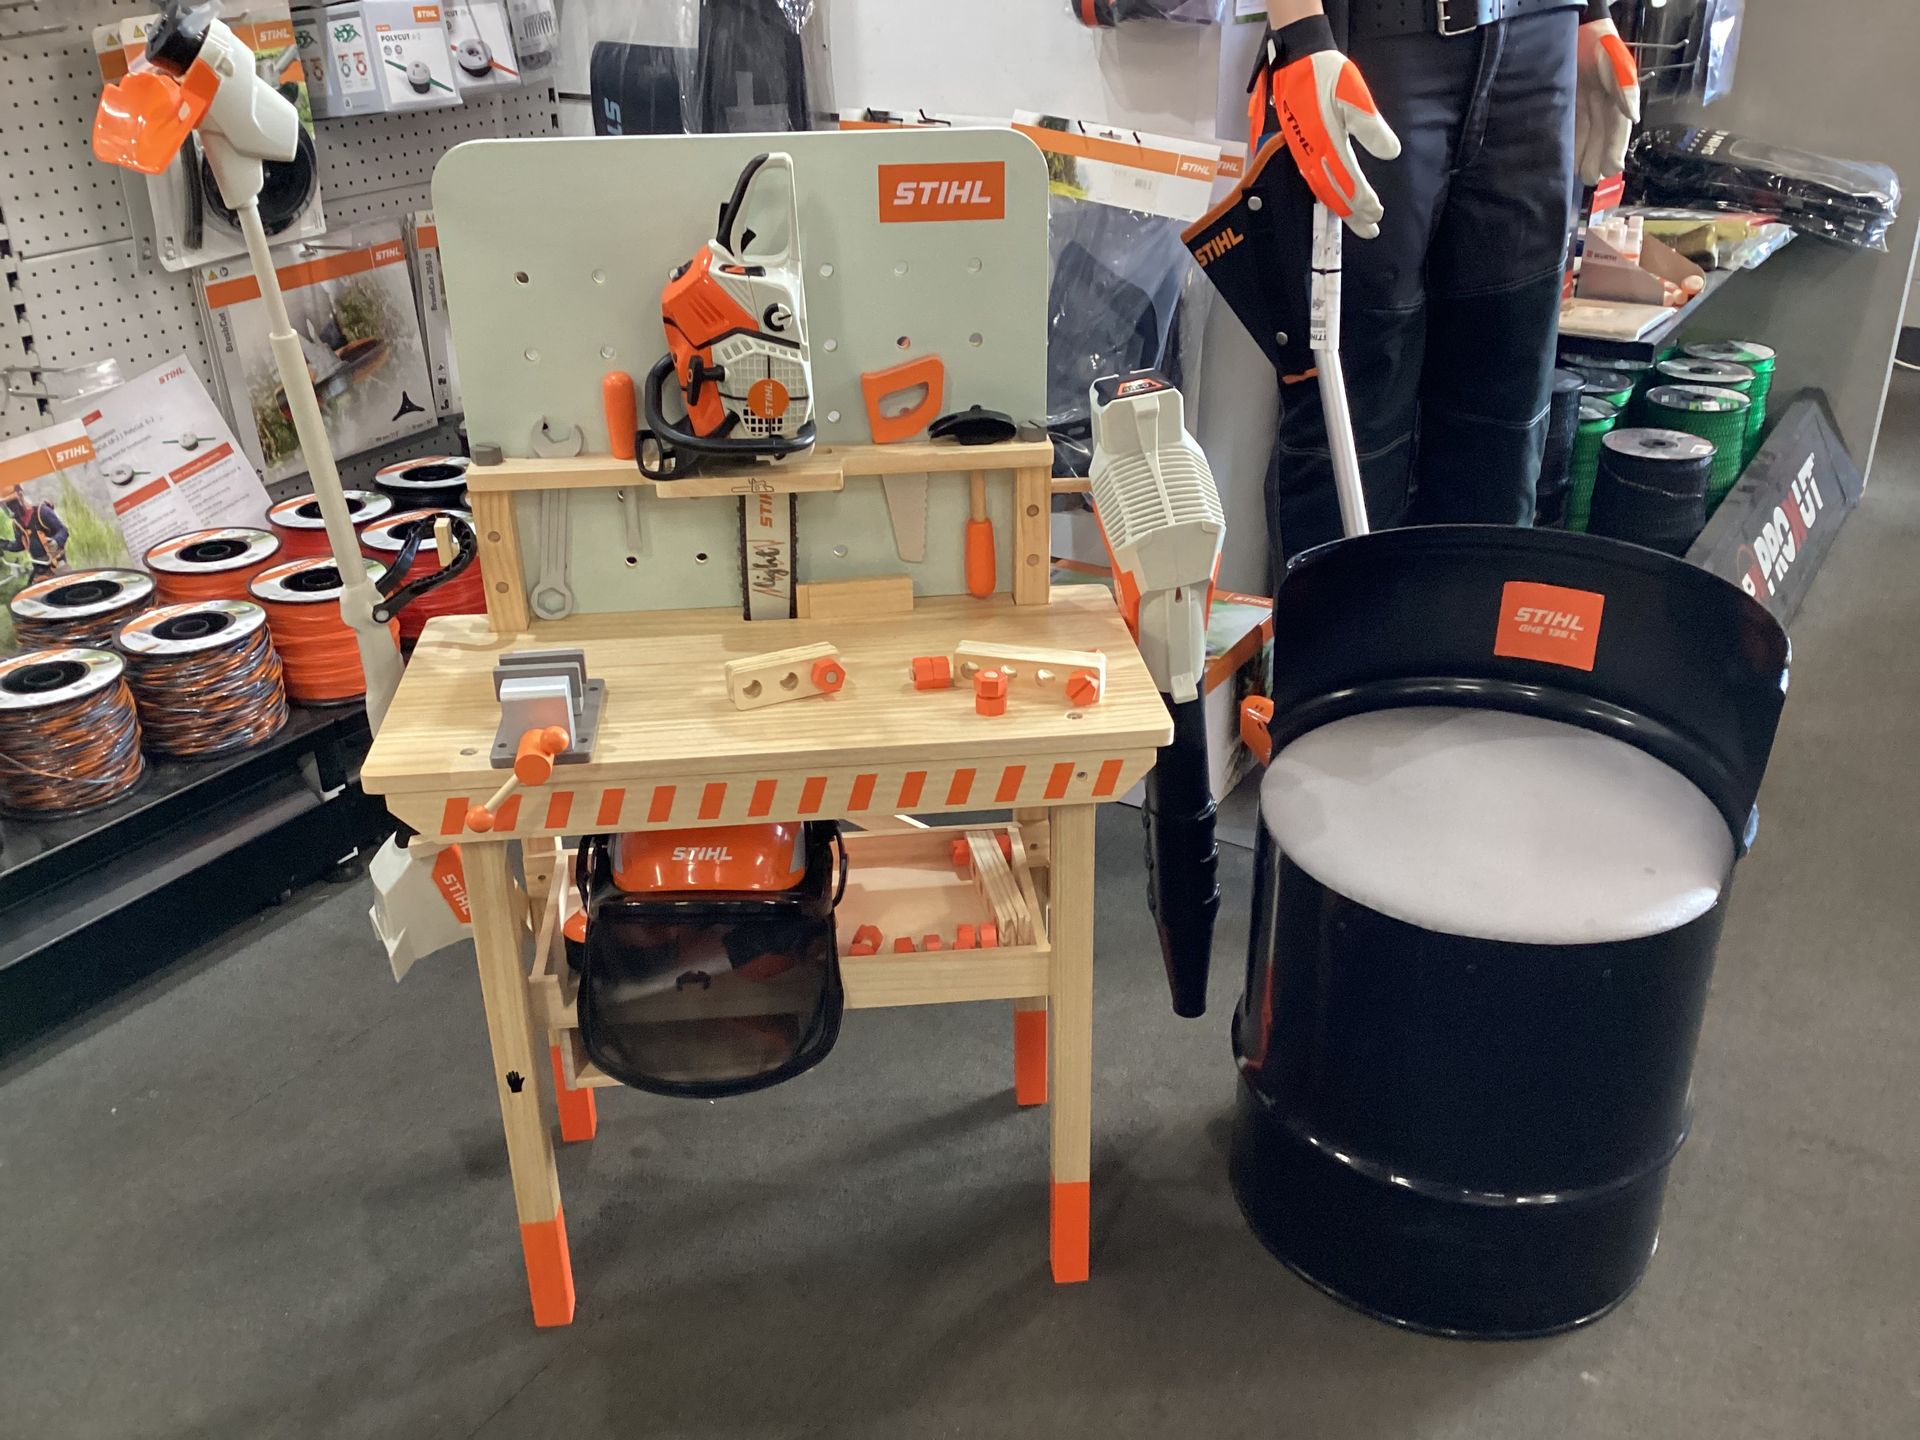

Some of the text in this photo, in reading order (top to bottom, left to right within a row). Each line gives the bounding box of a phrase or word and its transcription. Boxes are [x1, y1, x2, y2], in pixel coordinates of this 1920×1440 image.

[259, 28, 290, 42] STIHL
[380, 33, 410, 42] POLYCUT
[1283, 100, 1311, 156] STIHL
[1181, 162, 1210, 175] STIHL
[1217, 161, 1239, 172] TIHL
[893, 180, 992, 206] STIHL
[375, 247, 401, 261] STIHL
[1195, 227, 1244, 267] STIHL
[159, 367, 185, 385] STIHL
[763, 383, 774, 416] STIHL
[56, 444, 90, 463] STIHL
[1514, 607, 1584, 631] STIHL
[671, 847, 733, 861] STIHL
[441, 873, 469, 915] STIHL
